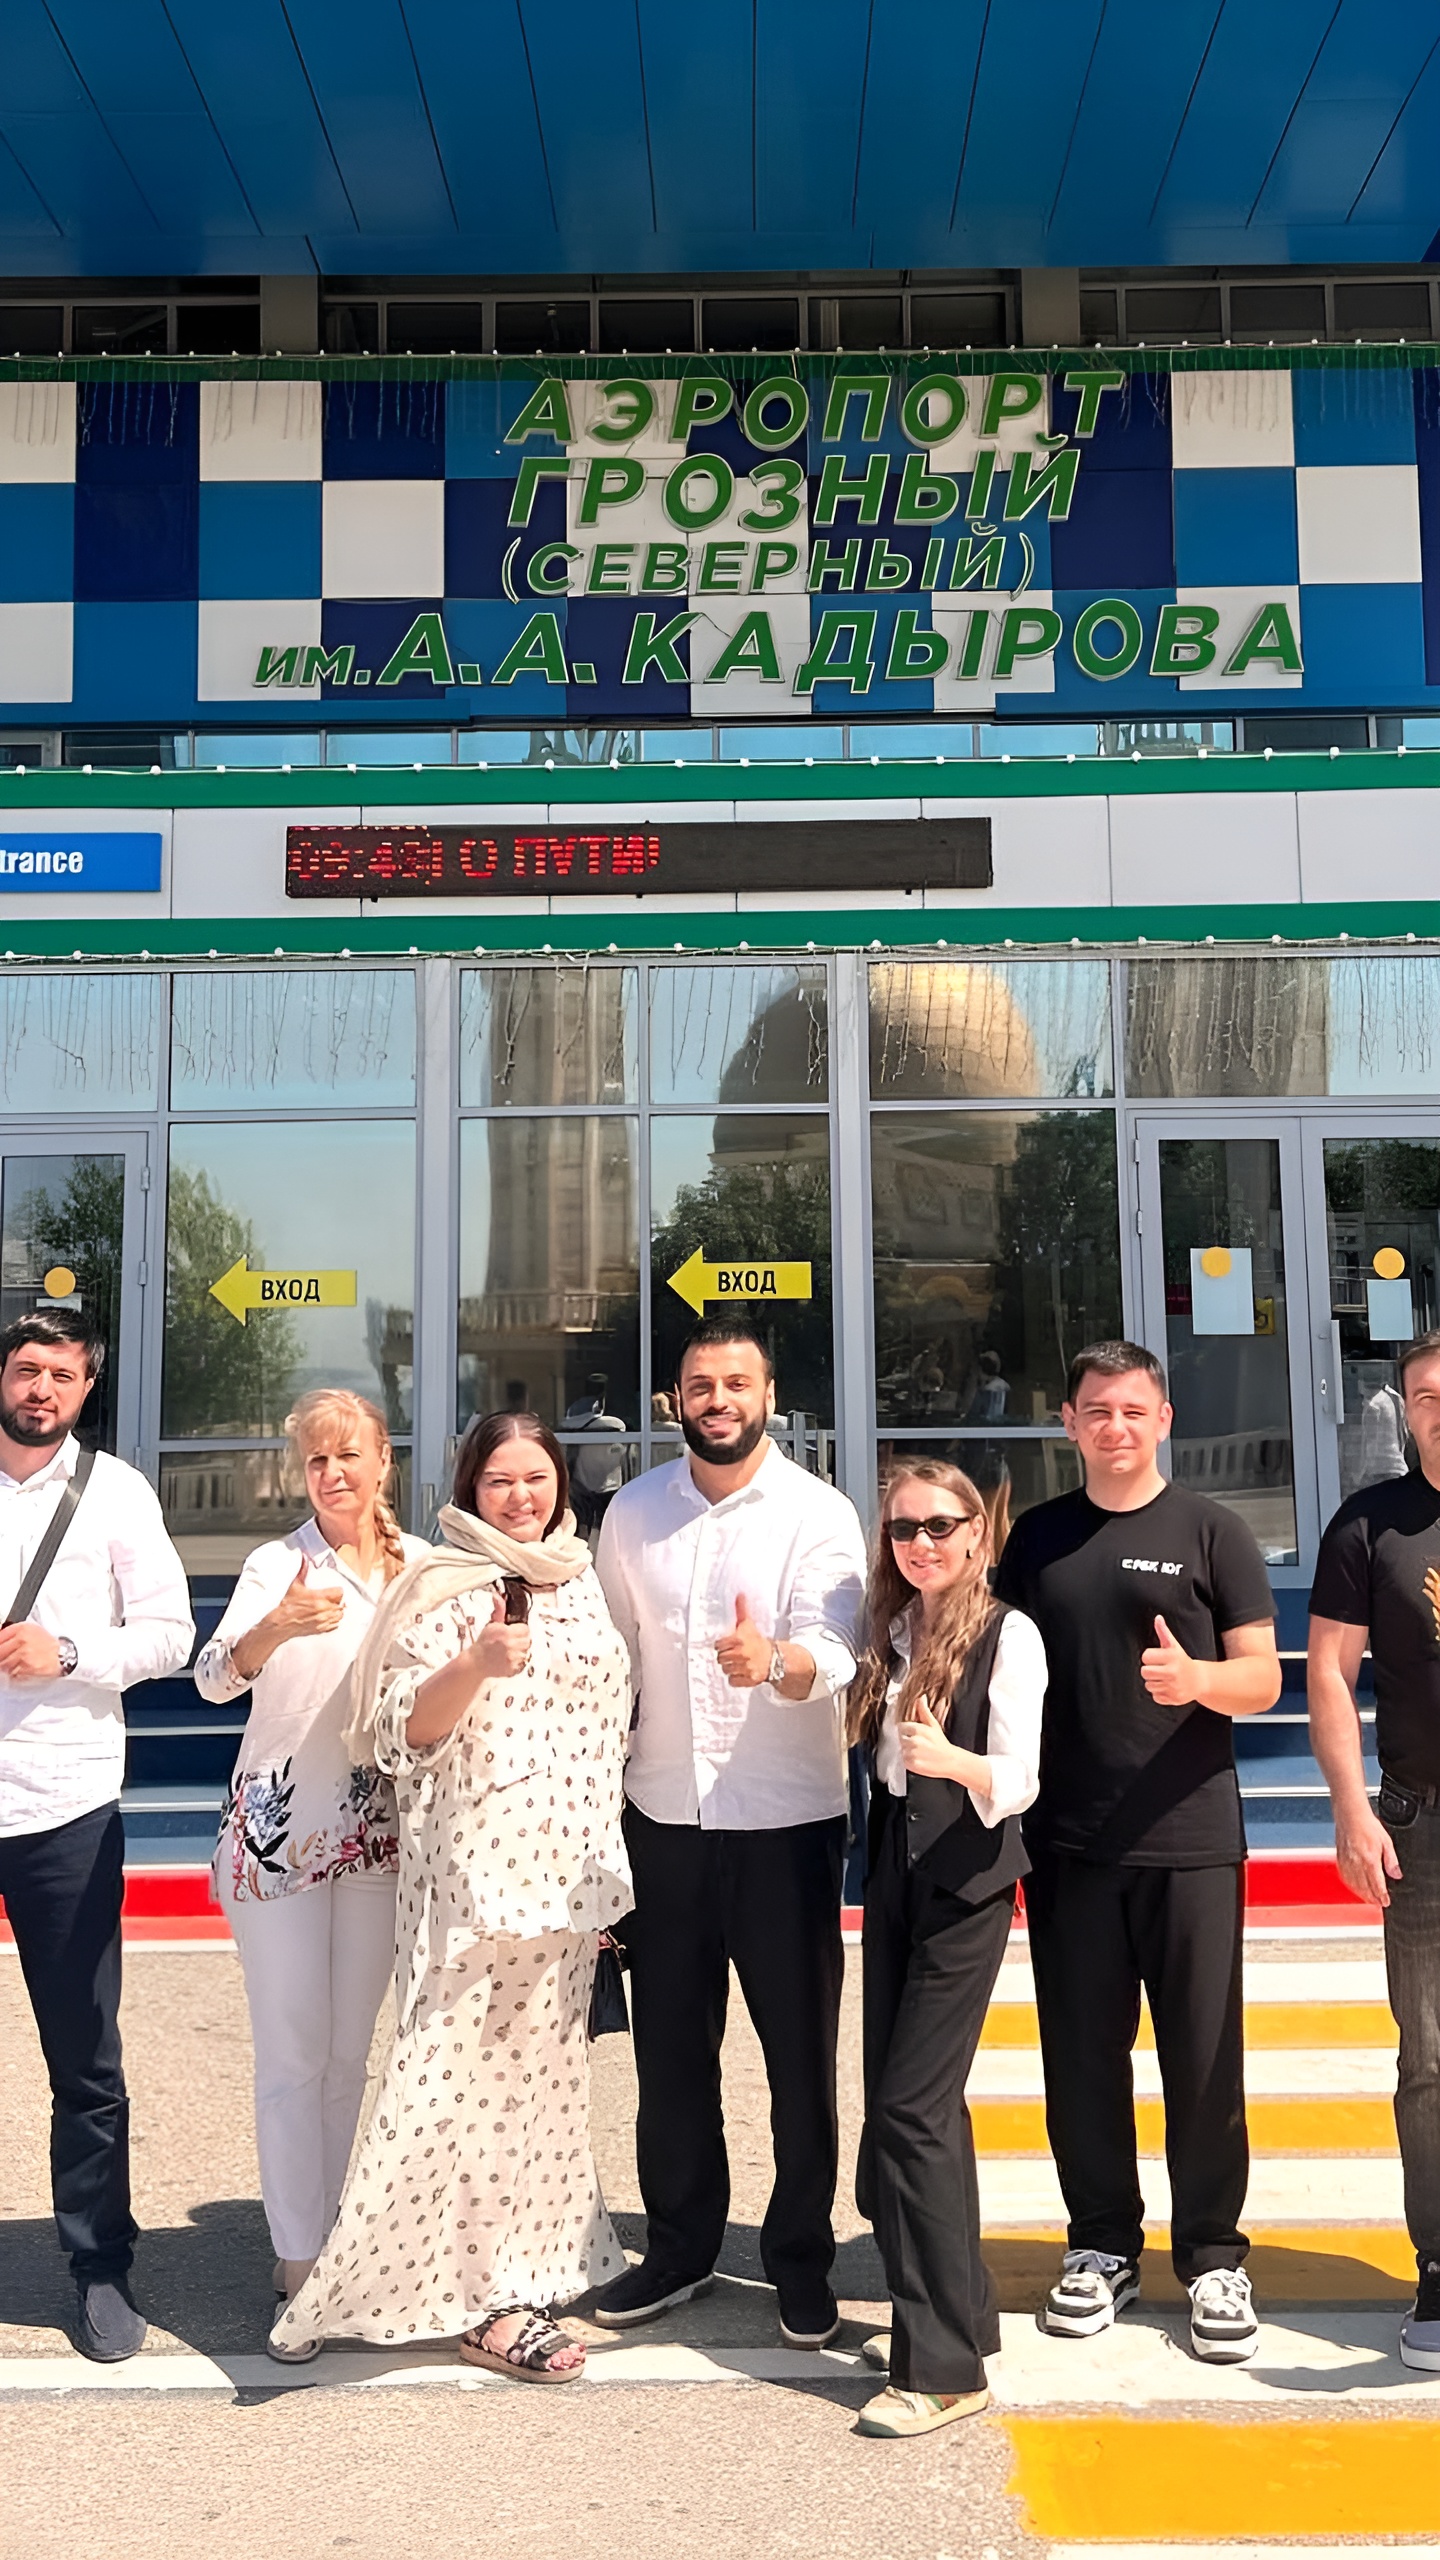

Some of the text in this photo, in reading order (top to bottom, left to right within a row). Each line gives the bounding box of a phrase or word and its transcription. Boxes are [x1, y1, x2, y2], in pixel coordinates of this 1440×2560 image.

[504, 372, 1125, 451] АЭРОПОРТ
[507, 432, 1081, 532] ГРОЗНЫЙ
[501, 521, 1034, 604] (СЕВЕРНЫЙ)
[622, 598, 1303, 696] КАДЫРОВА
[262, 1279, 320, 1302] ВХОД
[718, 1270, 776, 1295] ВХОД
